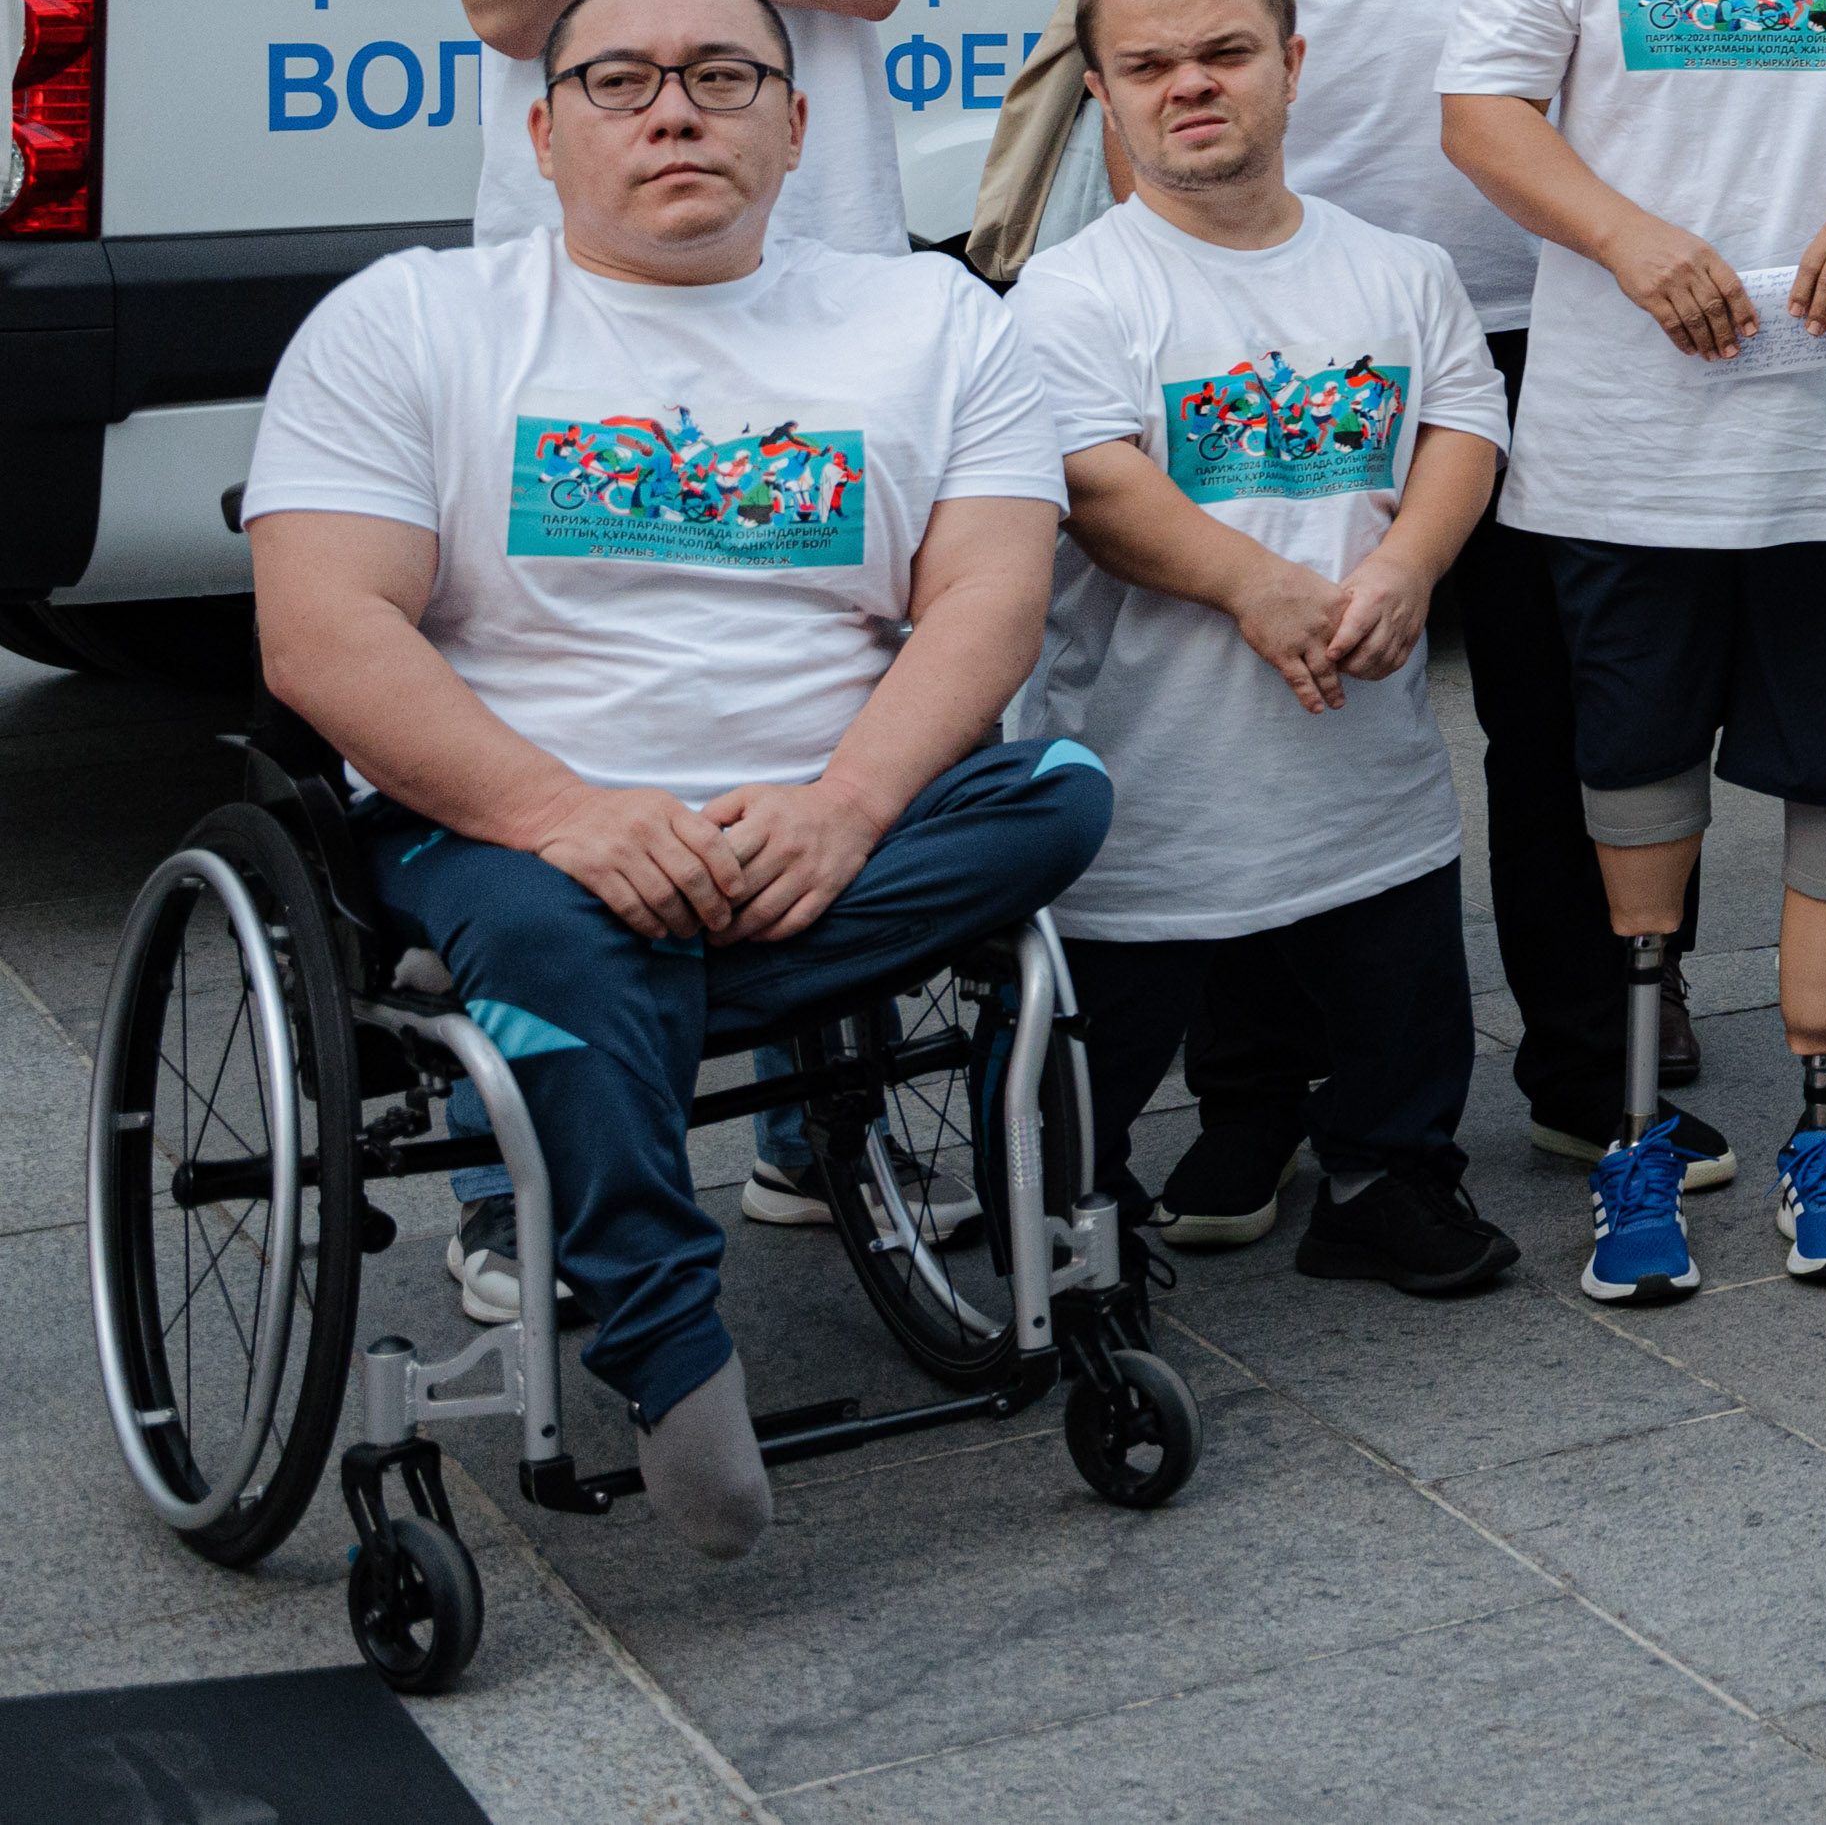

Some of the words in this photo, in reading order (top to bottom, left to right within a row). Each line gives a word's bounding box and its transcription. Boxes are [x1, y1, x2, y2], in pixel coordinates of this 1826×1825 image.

[1645, 34, 1711, 43] ПАРИЖ-2024
[1713, 34, 1804, 45] ПАРАЛИМПИАДА
[1650, 45, 1692, 55] ҰЛТТЫҚ
[1694, 45, 1755, 55] ҚҰРАМАНЫ
[1685, 58, 1697, 68] 28
[1699, 58, 1738, 67] ТАМЫЗ
[1754, 56, 1811, 70] ҚЫРКҮЙЕК
[885, 32, 1043, 112] ФЕ
[627, 518, 733, 540] ПАРАЛИМПИАДА
[735, 525, 839, 541] ОЙЫНДАРЫНДА
[603, 530, 676, 545] ҚҰРАМАНЫ
[589, 545, 604, 555] 28
[607, 545, 657, 558] ТАМЫЗ
[746, 556, 776, 566] 2024
